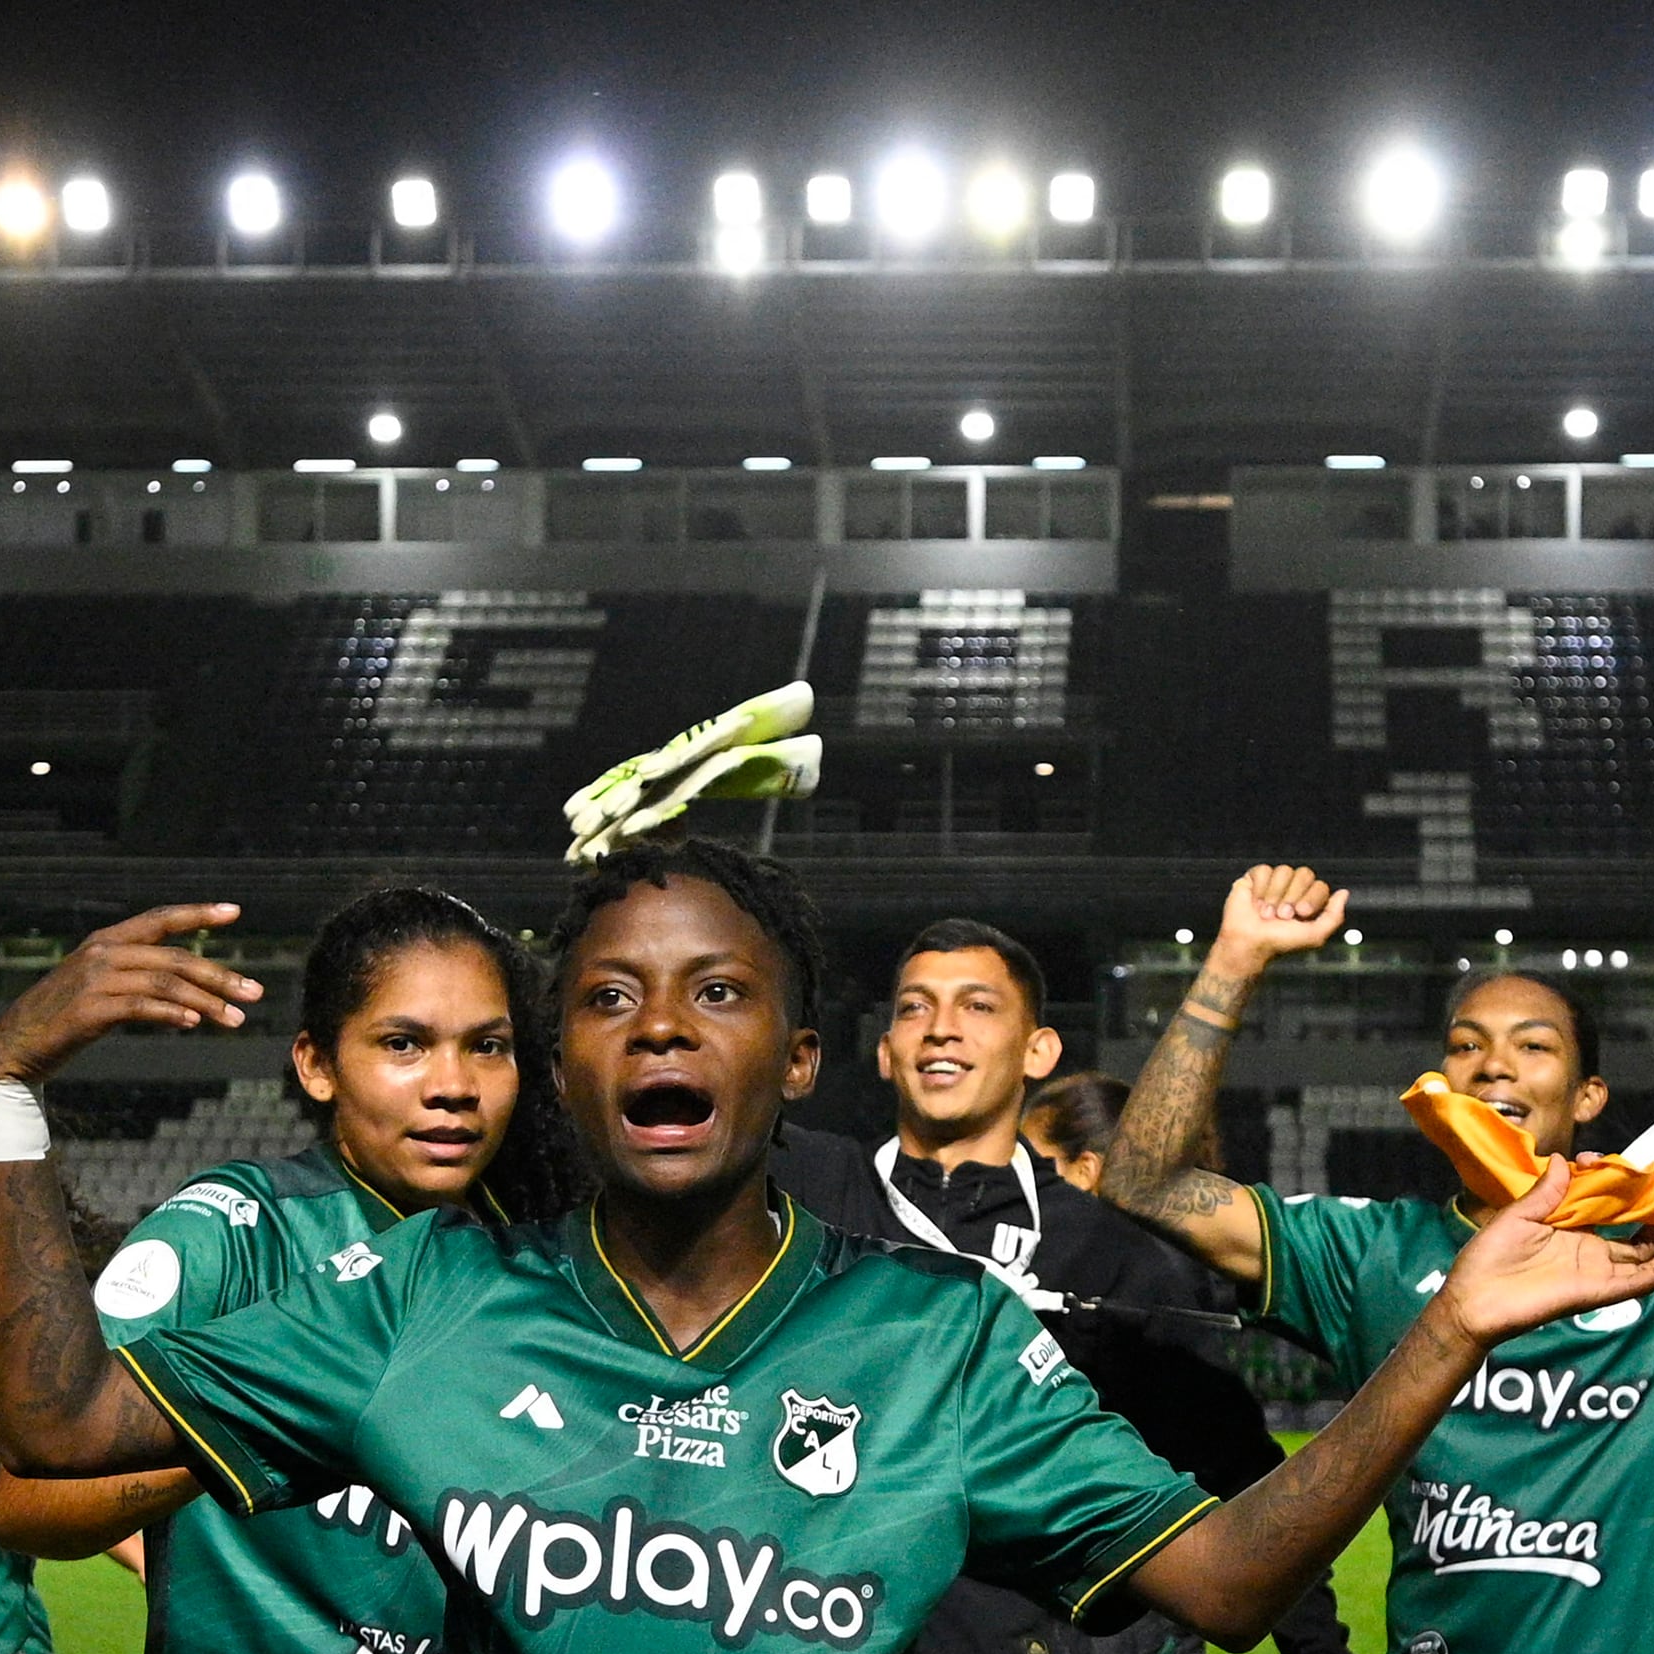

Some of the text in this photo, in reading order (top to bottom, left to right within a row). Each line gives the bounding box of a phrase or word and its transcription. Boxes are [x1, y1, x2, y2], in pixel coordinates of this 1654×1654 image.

[1451, 1356, 1641, 1429] lay.co
[791, 1403, 852, 1428] DEPORTIVO
[634, 1424, 726, 1468] Pizza
[1452, 1484, 1492, 1517] La
[1413, 1499, 1598, 1564] Muñeca
[444, 1498, 865, 1638] Wplay.co
[349, 1622, 406, 1654] STAS
